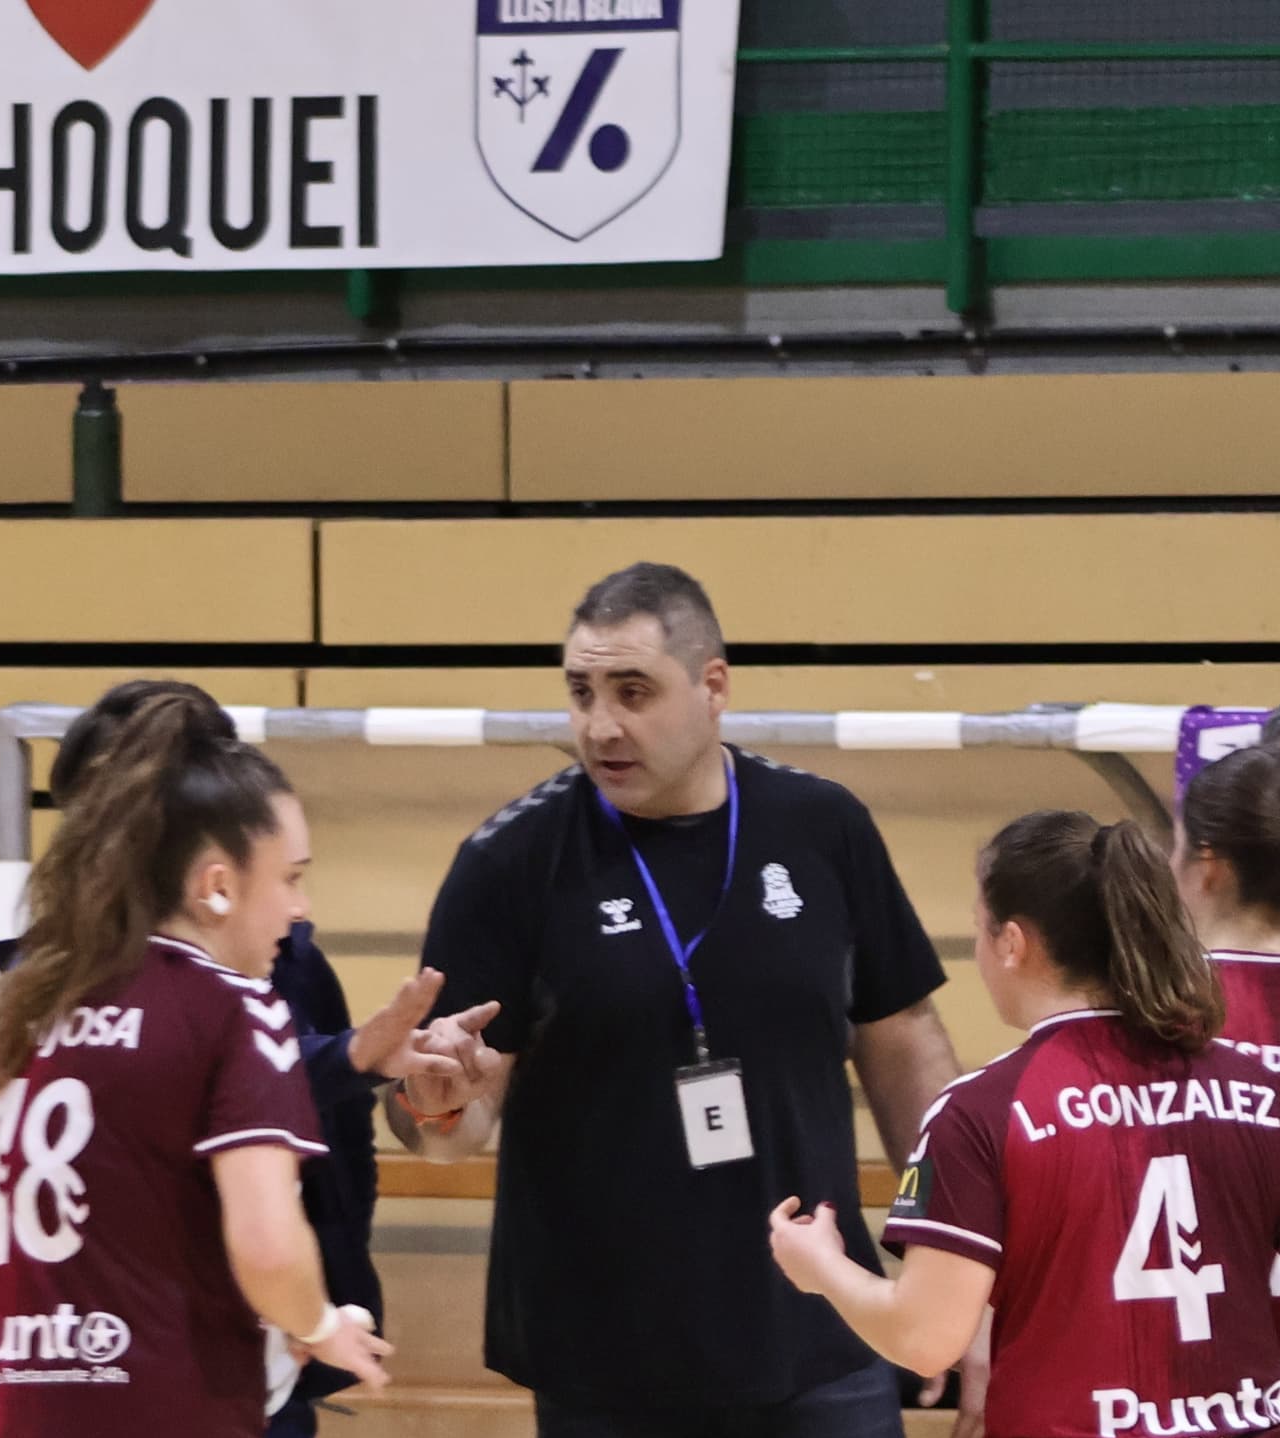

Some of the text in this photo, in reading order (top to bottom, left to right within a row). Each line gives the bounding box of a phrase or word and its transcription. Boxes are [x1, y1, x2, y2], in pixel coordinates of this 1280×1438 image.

[703, 1105, 725, 1132] E
[1012, 1098, 1058, 1143] L.
[1112, 1154, 1226, 1343] 4
